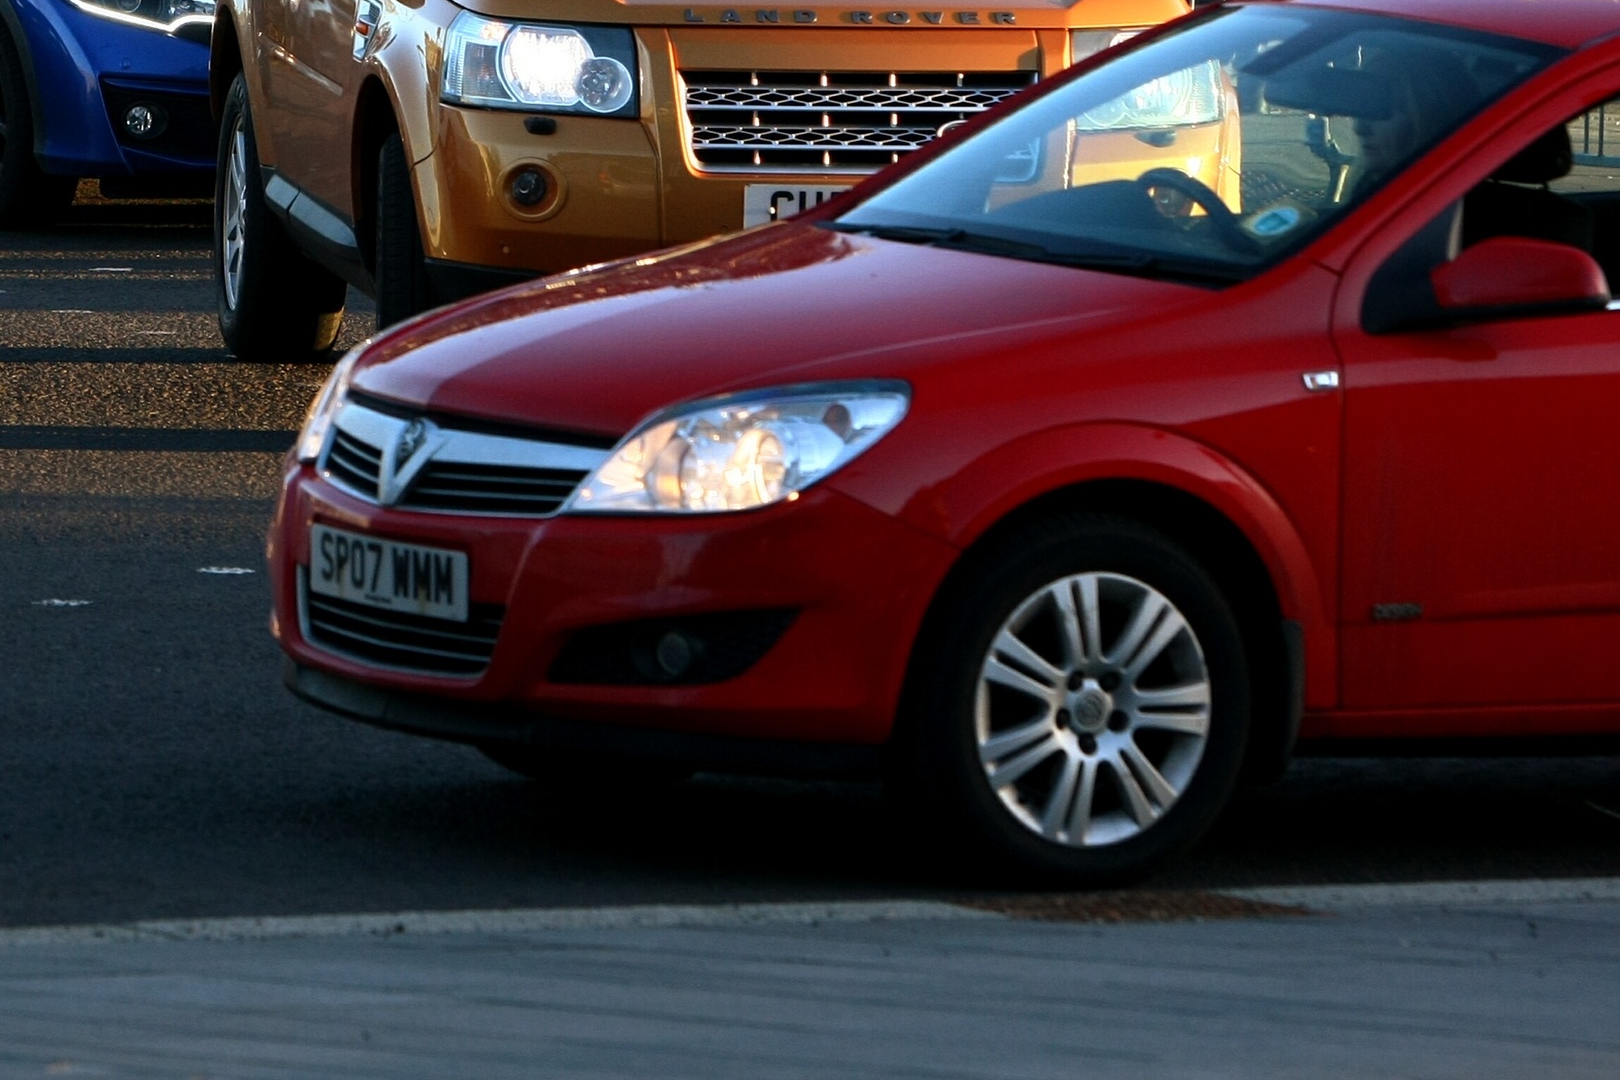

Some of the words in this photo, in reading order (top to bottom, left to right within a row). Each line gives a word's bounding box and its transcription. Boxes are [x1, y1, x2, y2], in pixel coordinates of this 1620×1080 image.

[684, 7, 818, 25] LAND
[851, 9, 1018, 25] ROVER
[320, 531, 383, 594] SP07
